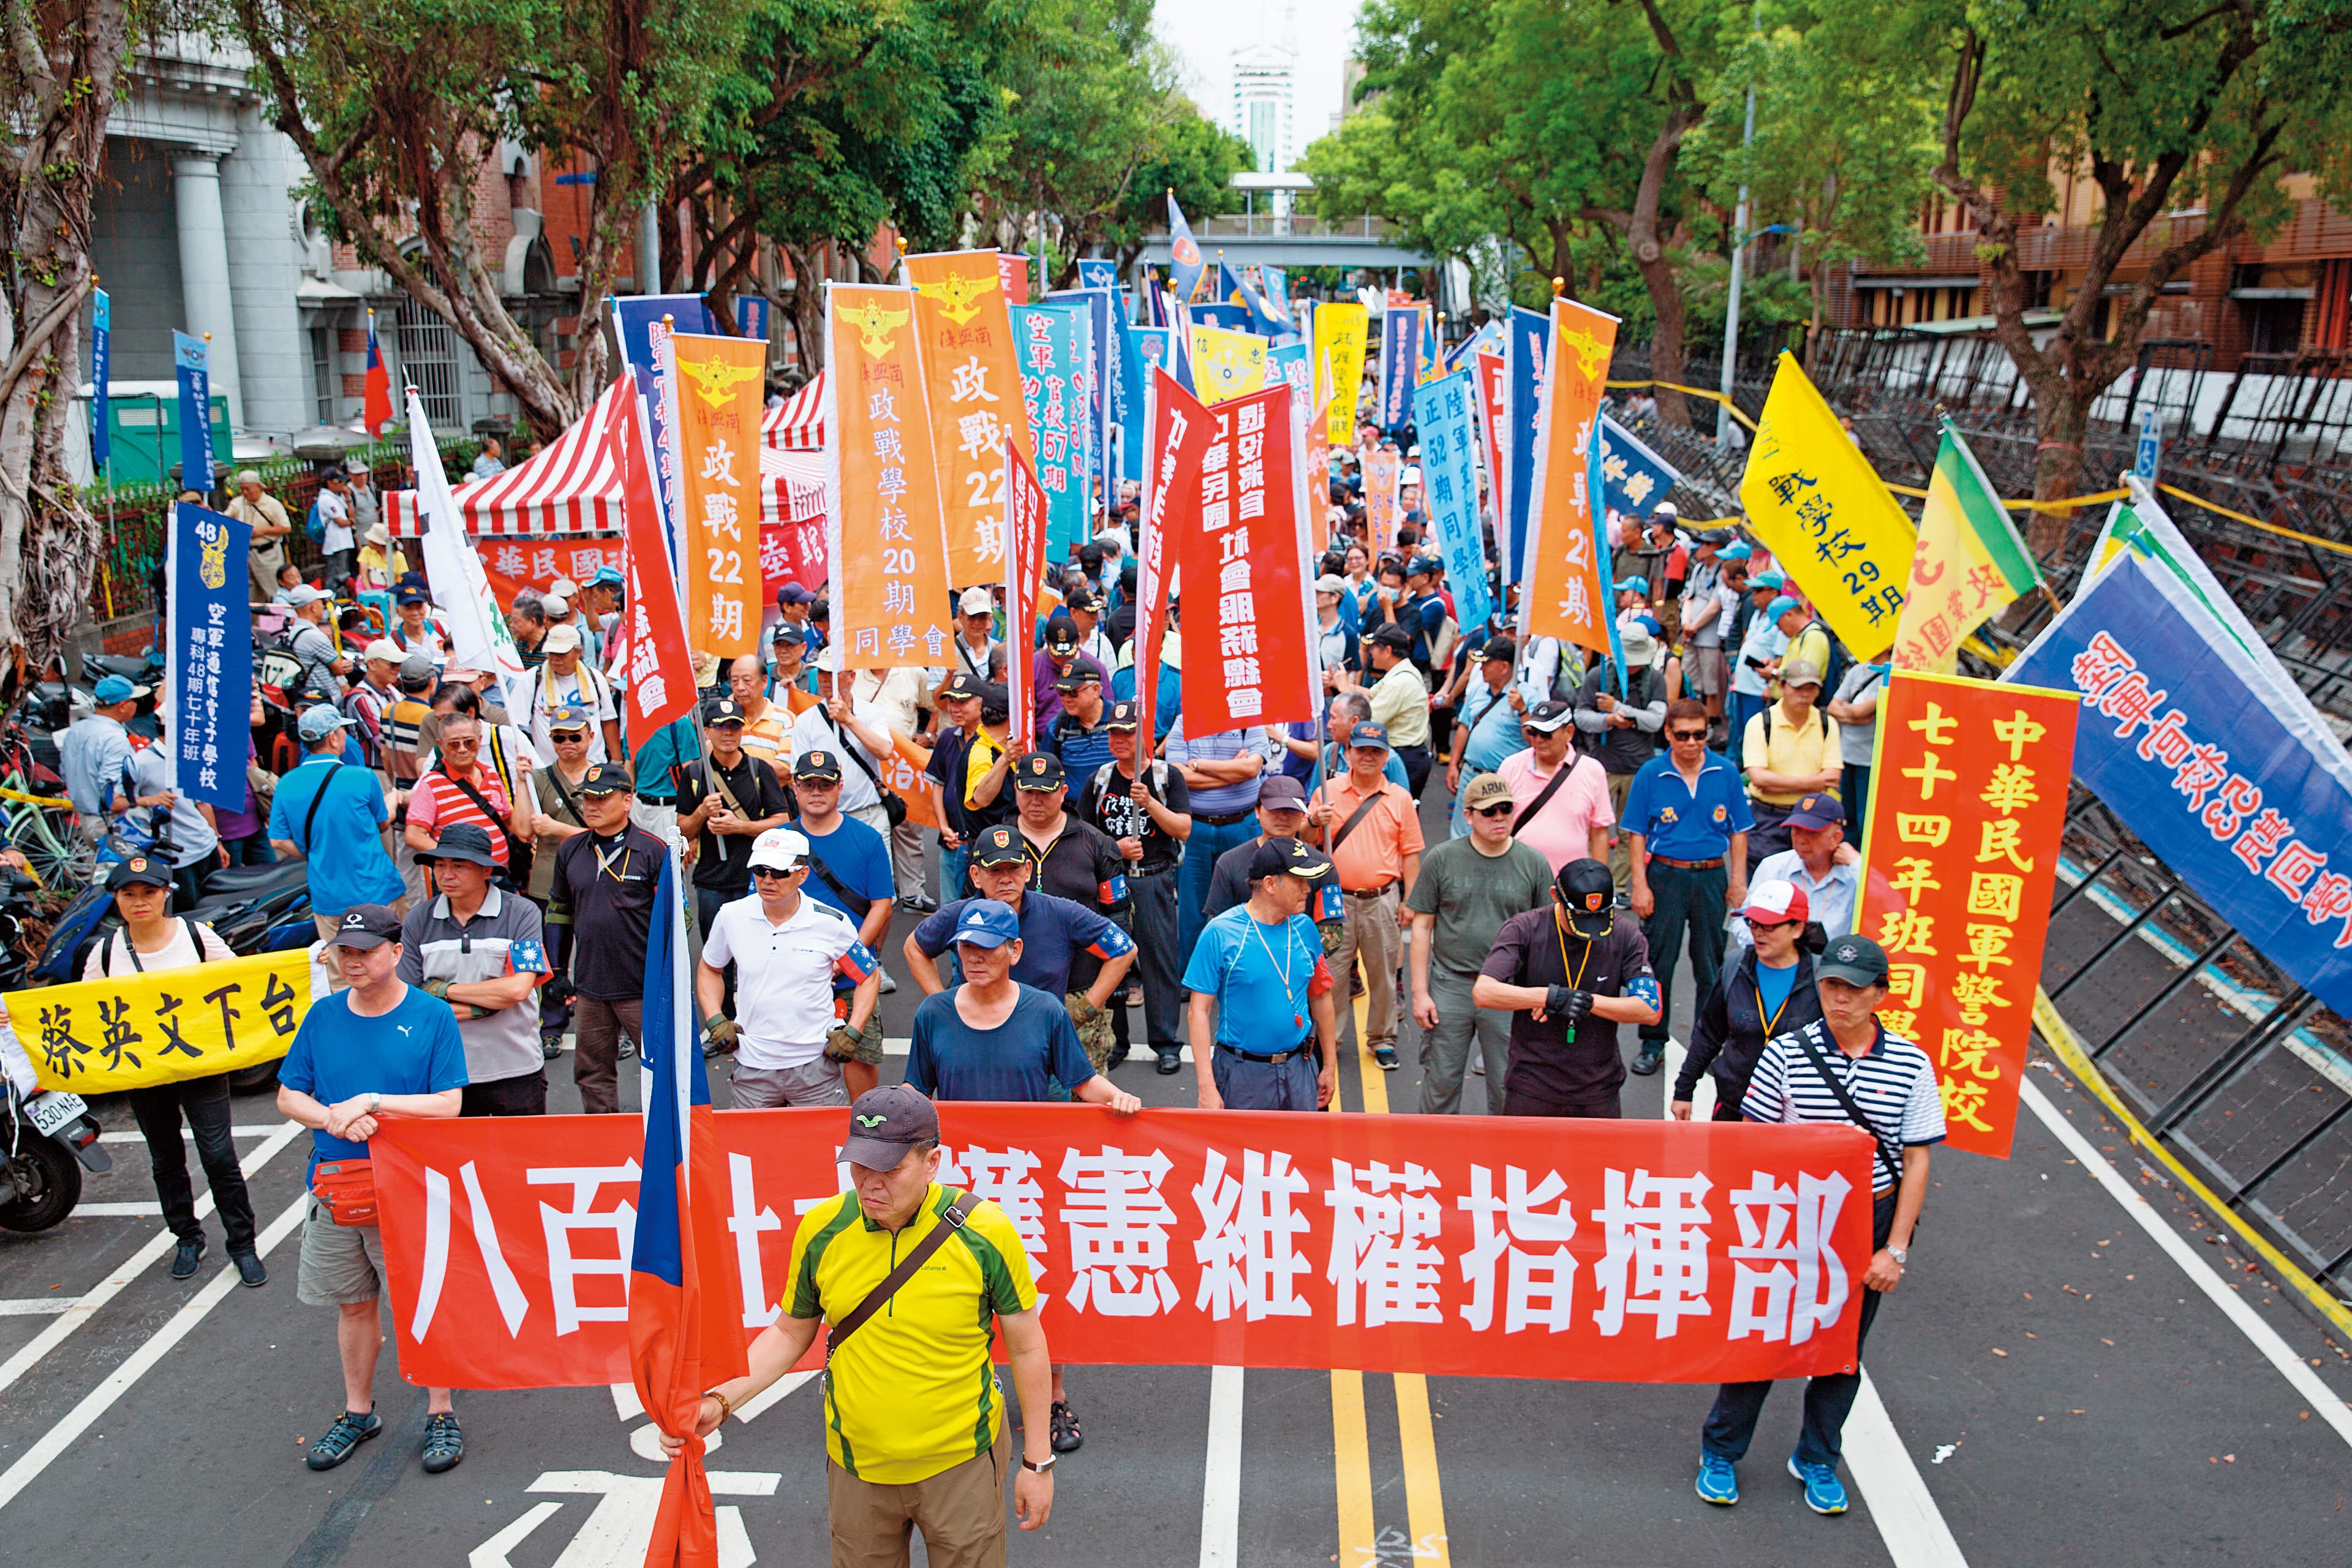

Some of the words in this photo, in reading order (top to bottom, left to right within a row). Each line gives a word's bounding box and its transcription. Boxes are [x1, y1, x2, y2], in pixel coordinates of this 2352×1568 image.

[1026, 312, 1055, 375] 空軍
[869, 386, 917, 615] 政戰學校20期
[951, 356, 1006, 564] 政戰22期
[1042, 374, 1068, 494] 官校57期
[1424, 396, 1477, 617] 正52期同學會
[195, 520, 217, 542] 48
[701, 438, 744, 642] 政戰22期
[183, 626, 206, 761] 專科48期七十年班
[199, 601, 227, 791] 空軍通信電子學校
[855, 624, 949, 658] 同學會
[1057, 643, 1070, 651] 22
[1481, 781, 1507, 796] ARMY
[1877, 701, 1959, 1050] 七十四年班同學
[1940, 709, 2048, 1133] 中華民國軍警院校
[39, 972, 296, 1080] 蔡英文下台
[411, 1143, 1853, 1346] 八百憲維權指揮部
